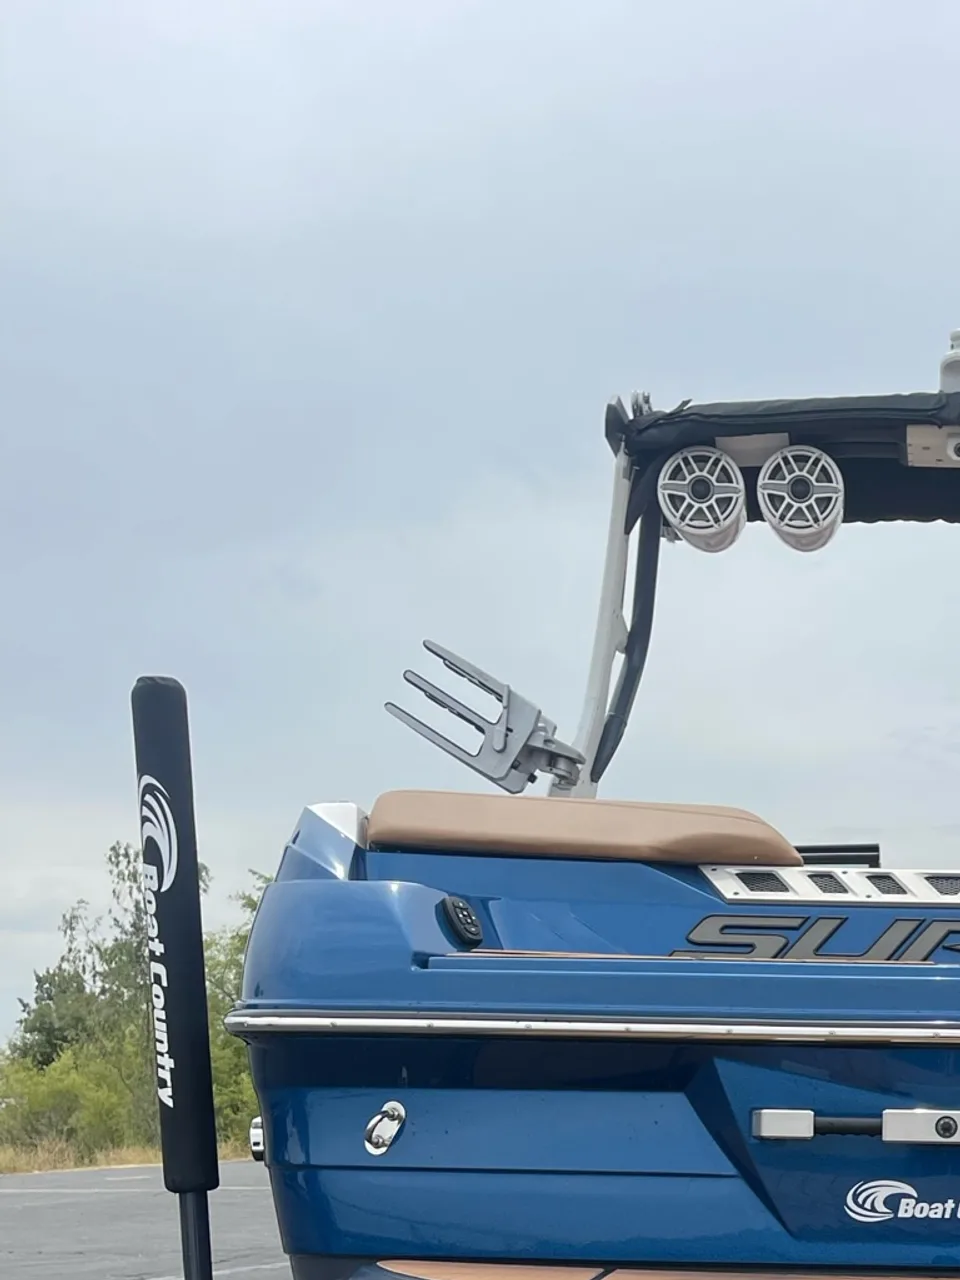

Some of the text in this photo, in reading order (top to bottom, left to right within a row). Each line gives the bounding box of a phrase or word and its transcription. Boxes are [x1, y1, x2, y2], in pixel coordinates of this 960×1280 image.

[142, 863, 175, 1108] Boat Country
[897, 1198, 955, 1219] Boat
